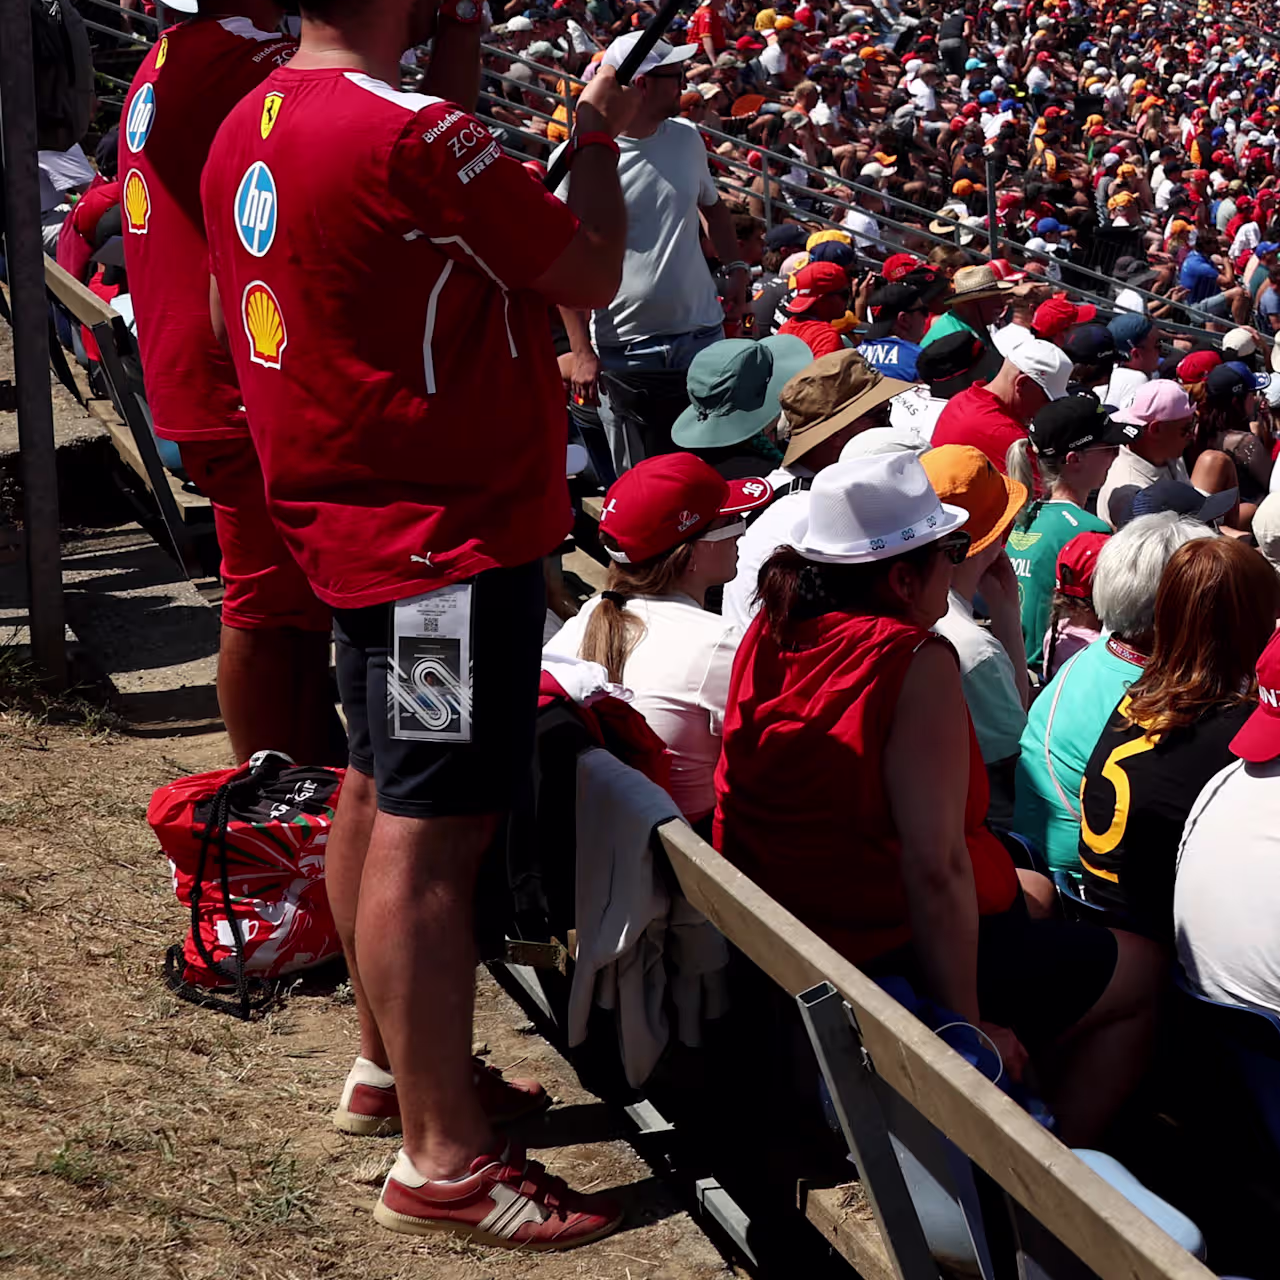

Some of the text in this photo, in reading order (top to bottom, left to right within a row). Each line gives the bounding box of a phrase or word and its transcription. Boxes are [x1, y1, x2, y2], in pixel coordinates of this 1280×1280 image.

[129, 83, 154, 151] hp
[447, 122, 487, 159] ZCG
[242, 163, 273, 254] hp
[1123, 424, 1139, 438] 18
[742, 479, 764, 497] 16
